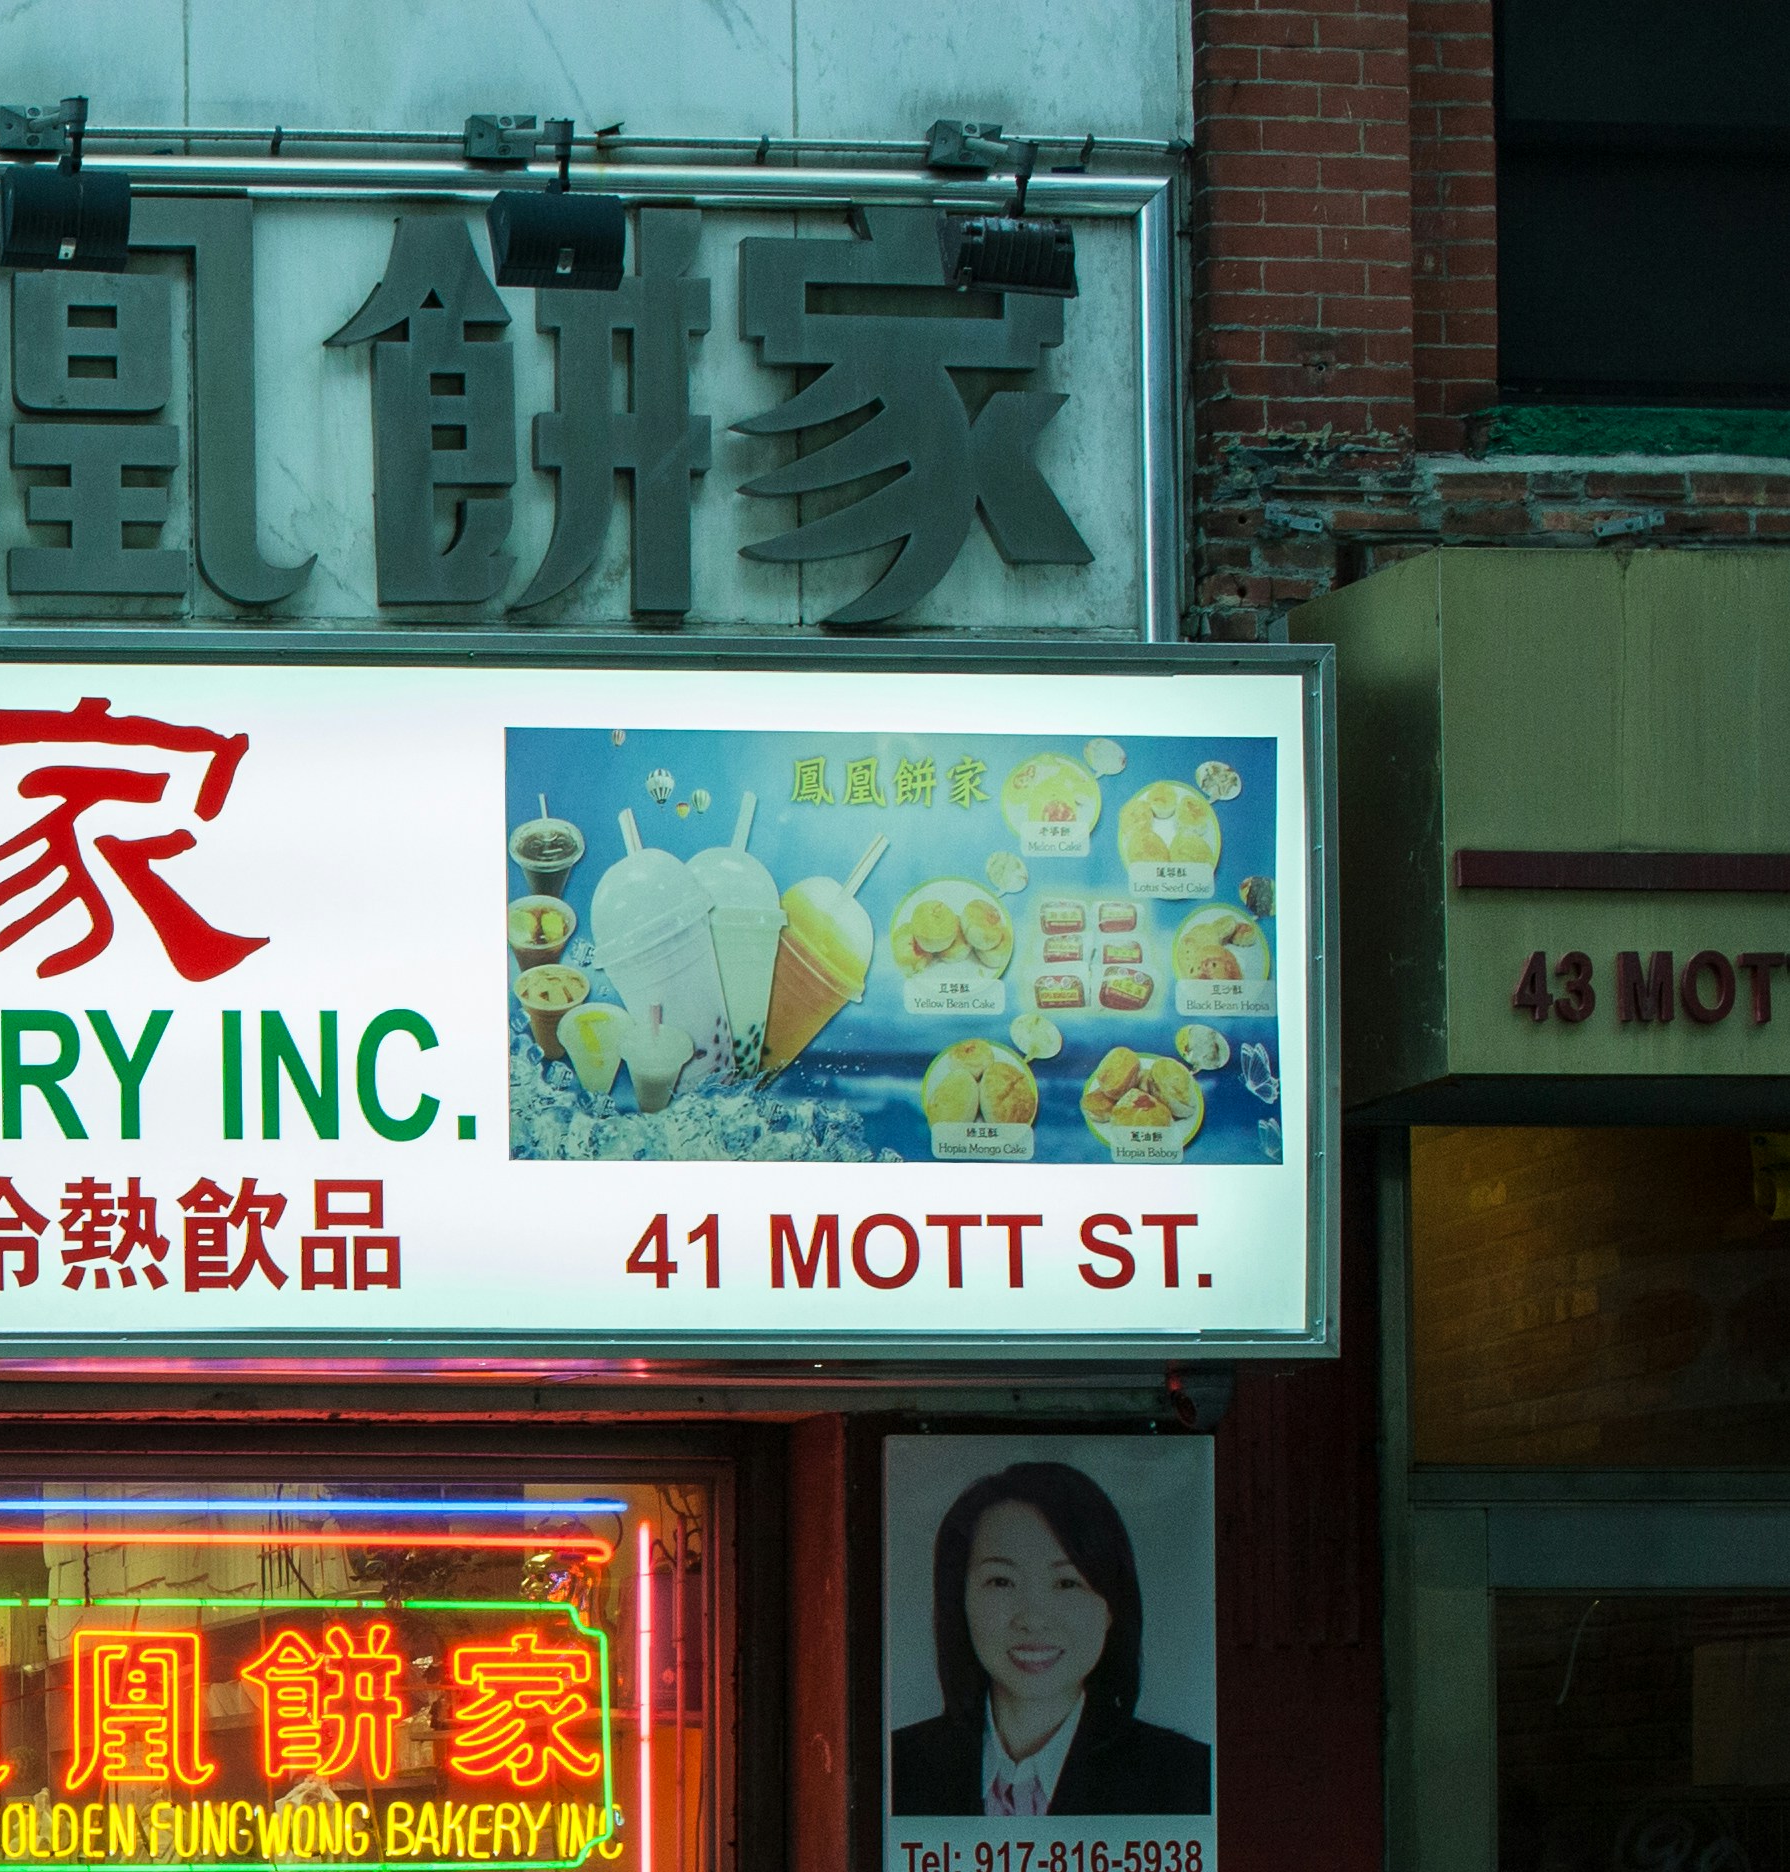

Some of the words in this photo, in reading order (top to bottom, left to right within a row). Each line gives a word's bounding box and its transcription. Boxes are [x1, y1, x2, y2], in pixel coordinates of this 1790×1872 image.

[791, 755, 991, 810] 鳳凰餅家
[1134, 882, 1159, 892] Lotus
[1163, 883, 1184, 892] Seed
[1187, 883, 1209, 893] Cake
[914, 998, 944, 1008] Yellow
[947, 999, 969, 1008] Bean
[972, 999, 995, 1009] Cake
[1513, 951, 1596, 1023] 43
[1617, 950, 1790, 1024] MOT
[1186, 999, 1211, 1010] Black
[1214, 1000, 1238, 1010] Bean
[1241, 1000, 1269, 1013] Hopia
[222, 1009, 476, 1141] INC.
[938, 1143, 967, 1155] Hopia
[969, 1143, 1000, 1156] Mongo
[1002, 1143, 1027, 1154] Cake
[1117, 1147, 1145, 1159] Hopia
[1148, 1148, 1178, 1159] Baboy
[626, 1214, 719, 1288] 41
[770, 1214, 1042, 1289] MOTT
[1079, 1214, 1212, 1289] ST.
[387, 1801, 546, 1860] BAKERY
